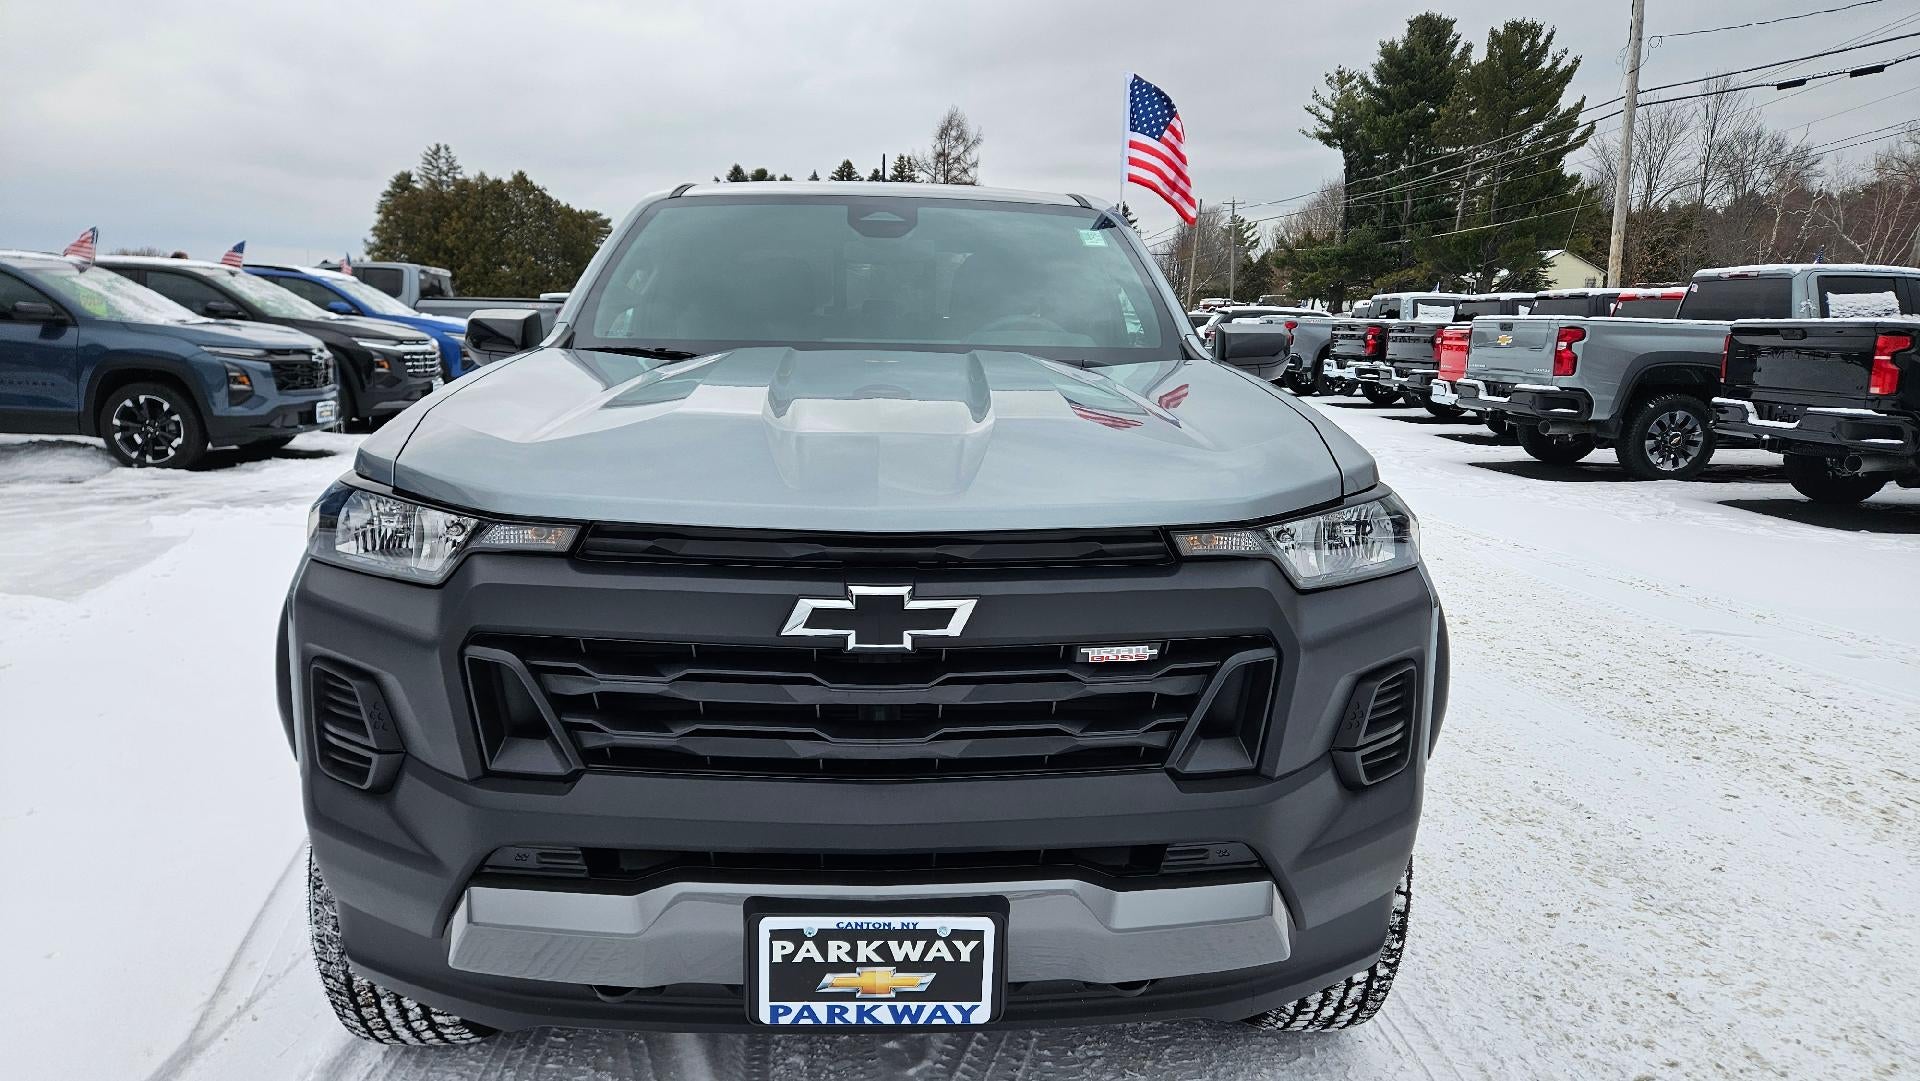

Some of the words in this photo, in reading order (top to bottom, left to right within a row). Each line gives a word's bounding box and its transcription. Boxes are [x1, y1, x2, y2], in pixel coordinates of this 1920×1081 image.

[1081, 646, 1158, 655] TRAIL
[1089, 653, 1149, 662] BOSS
[835, 921, 896, 931] CANTON,
[900, 921, 920, 930] NY
[771, 940, 981, 963] PARKWAY
[769, 1004, 981, 1025] PARKWAY
